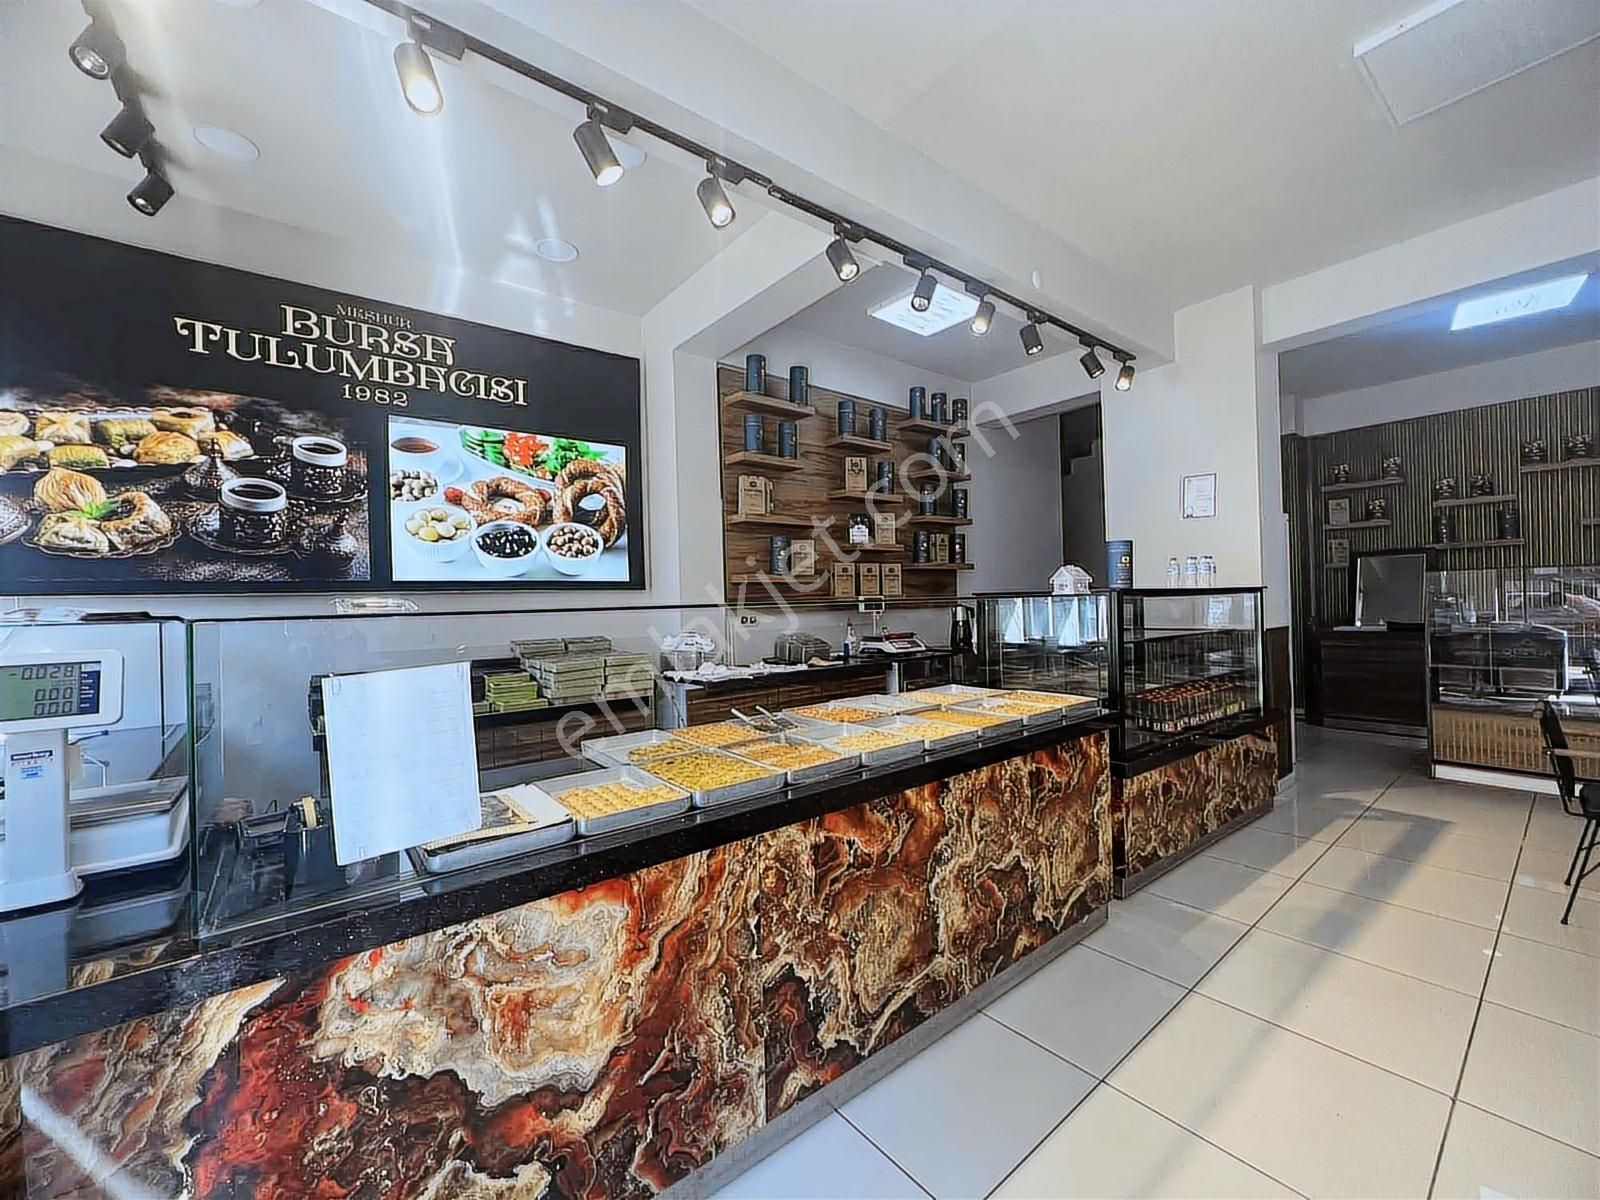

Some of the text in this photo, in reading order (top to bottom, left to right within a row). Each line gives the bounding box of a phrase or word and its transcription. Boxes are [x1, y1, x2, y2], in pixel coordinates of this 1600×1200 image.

[174, 316, 529, 406] TULUMBACISI
[281, 304, 456, 365] BURSA
[341, 384, 408, 407] 1982
